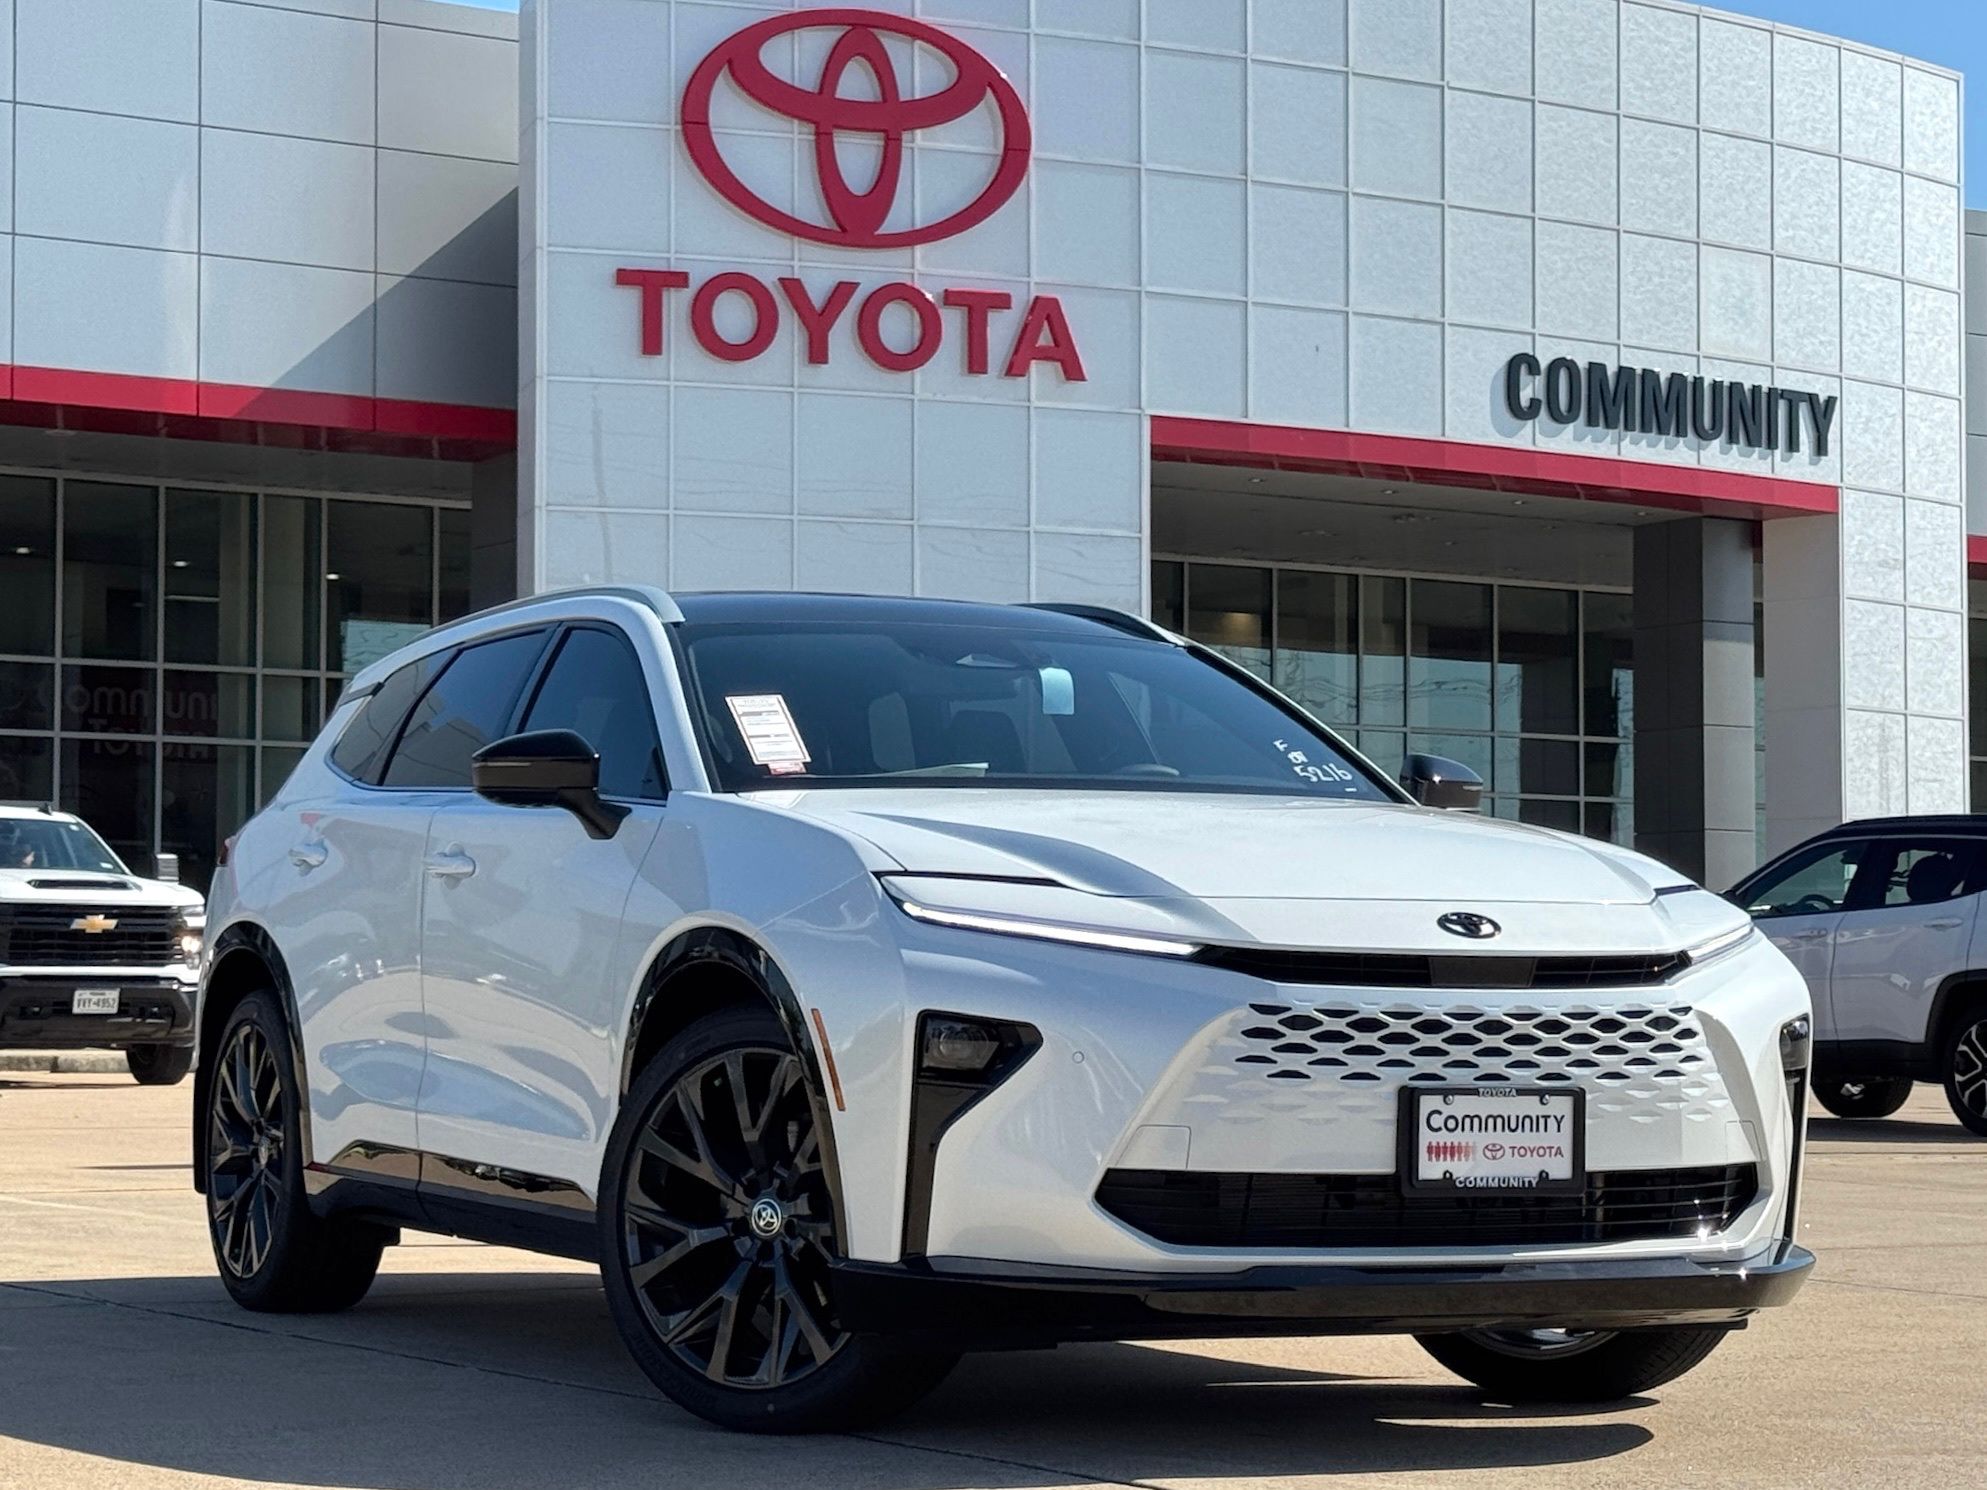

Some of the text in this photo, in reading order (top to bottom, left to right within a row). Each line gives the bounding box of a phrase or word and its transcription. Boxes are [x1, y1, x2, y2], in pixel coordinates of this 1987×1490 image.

[616, 268, 1088, 382] TOYOTA
[1506, 352, 1838, 457] COMMUNITY
[1478, 1088, 1517, 1098] TOYOTA
[1509, 1145, 1564, 1158] TOYOTA
[1455, 1176, 1539, 1188] COMMUNITY
